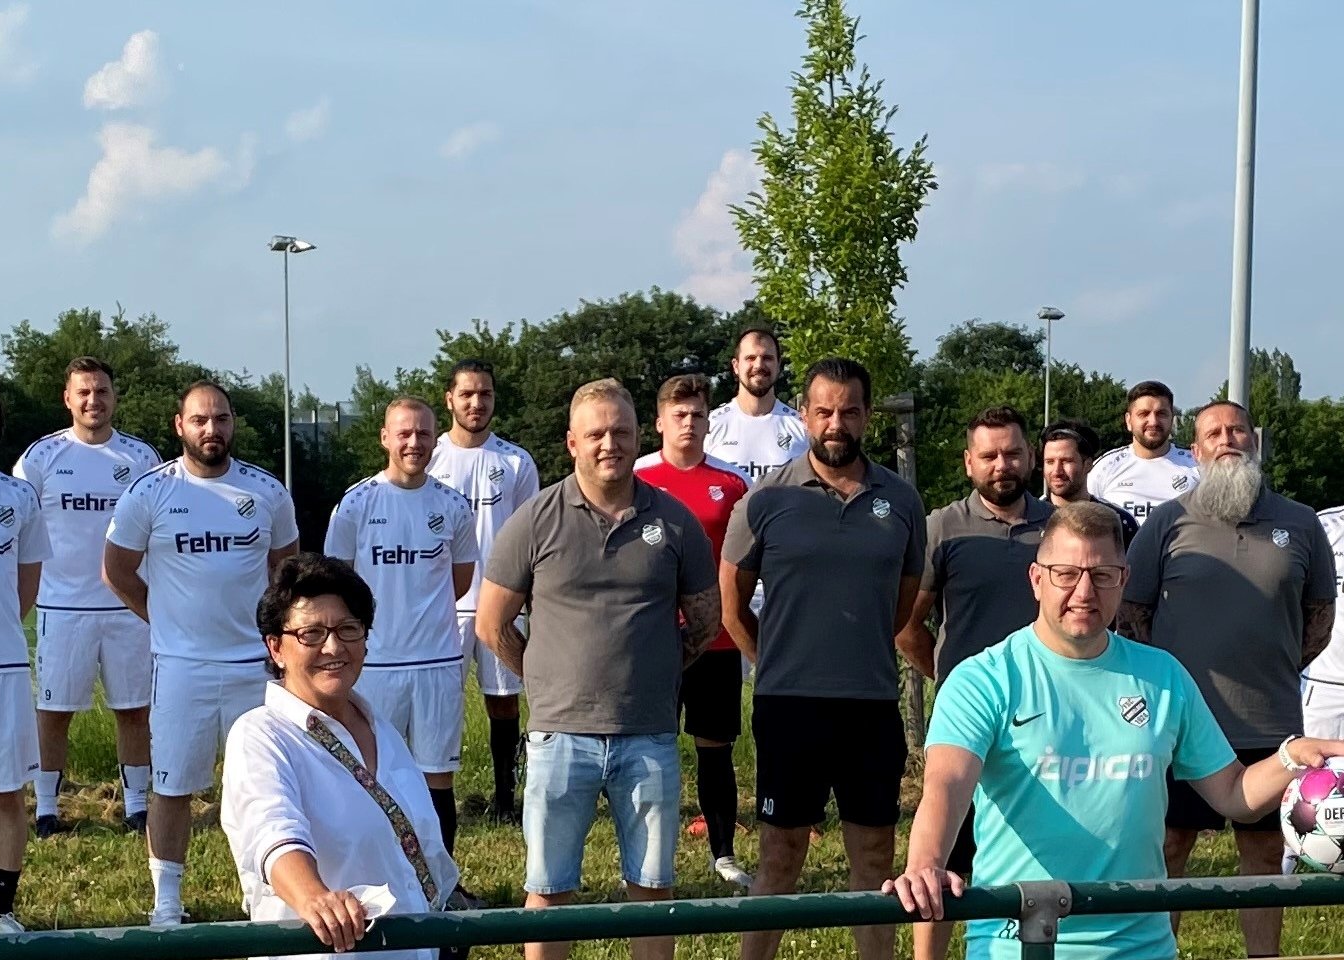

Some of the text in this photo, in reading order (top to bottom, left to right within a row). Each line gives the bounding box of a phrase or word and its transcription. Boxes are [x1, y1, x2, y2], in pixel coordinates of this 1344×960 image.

[61, 493, 108, 511] Fehr
[175, 530, 232, 553] Fehr
[371, 545, 419, 565] Fehr
[45, 689, 52, 700] 9
